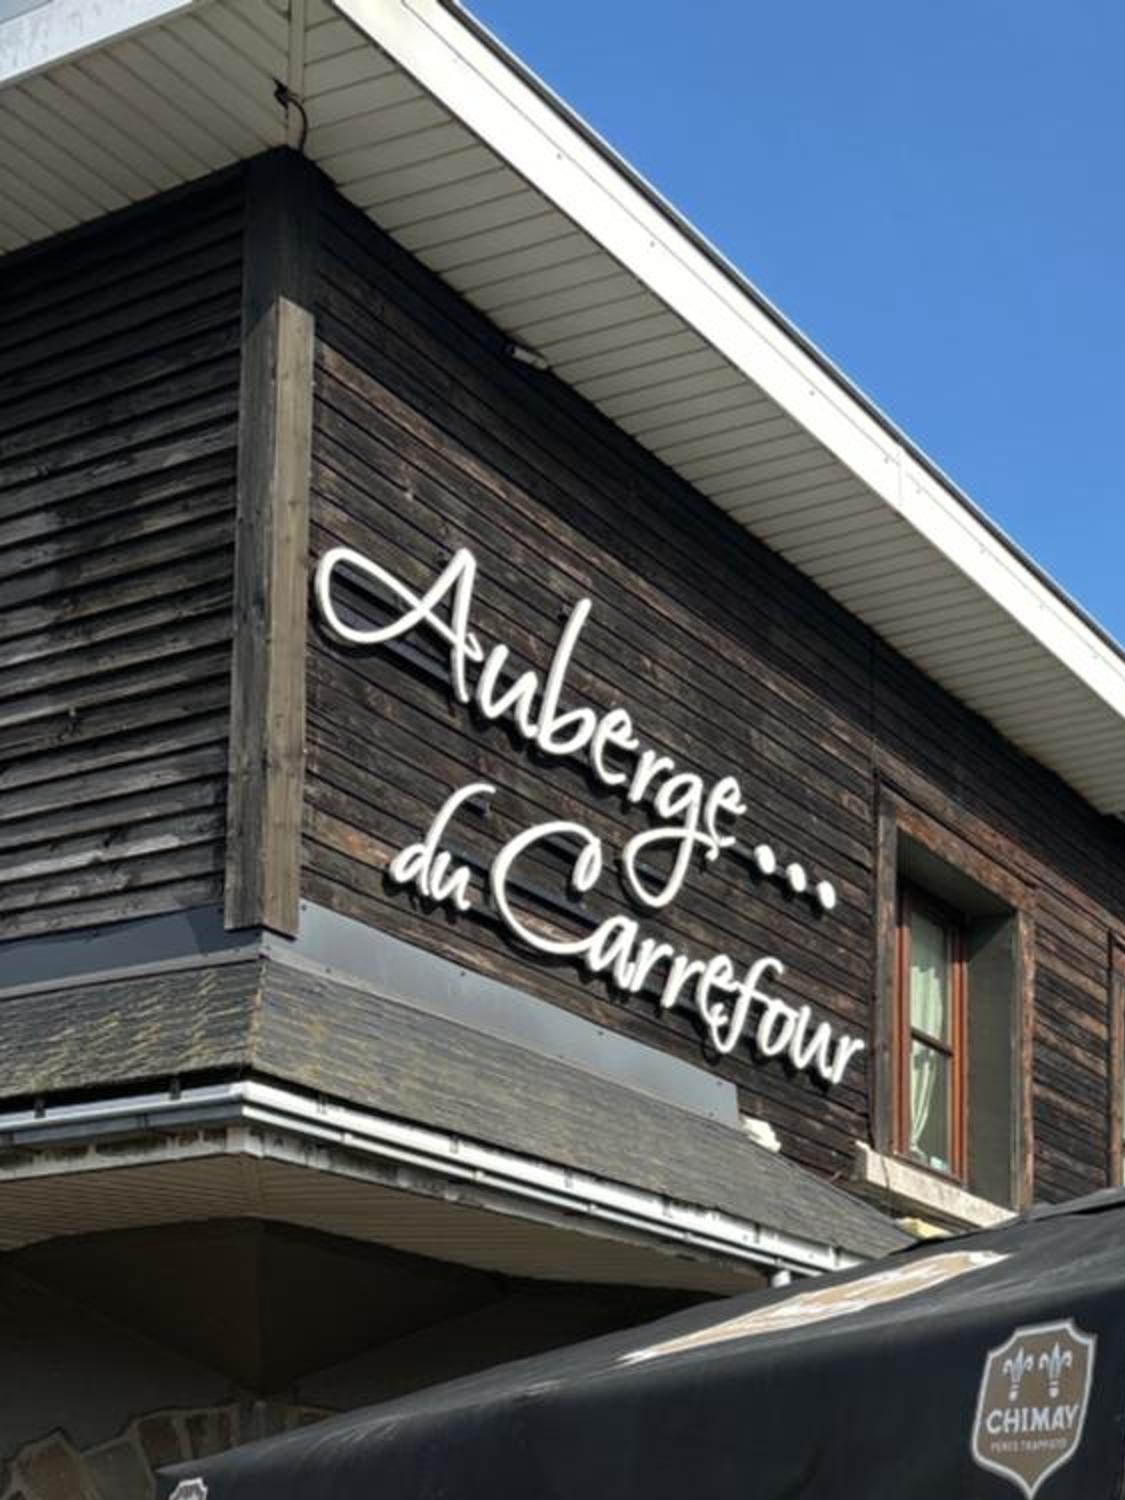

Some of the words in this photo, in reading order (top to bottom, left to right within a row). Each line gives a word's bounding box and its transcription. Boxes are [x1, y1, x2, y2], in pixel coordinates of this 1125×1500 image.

[389, 783, 496, 911] du
[491, 821, 865, 1084] Carrefour
[986, 1403, 1080, 1435] CHIMAY
